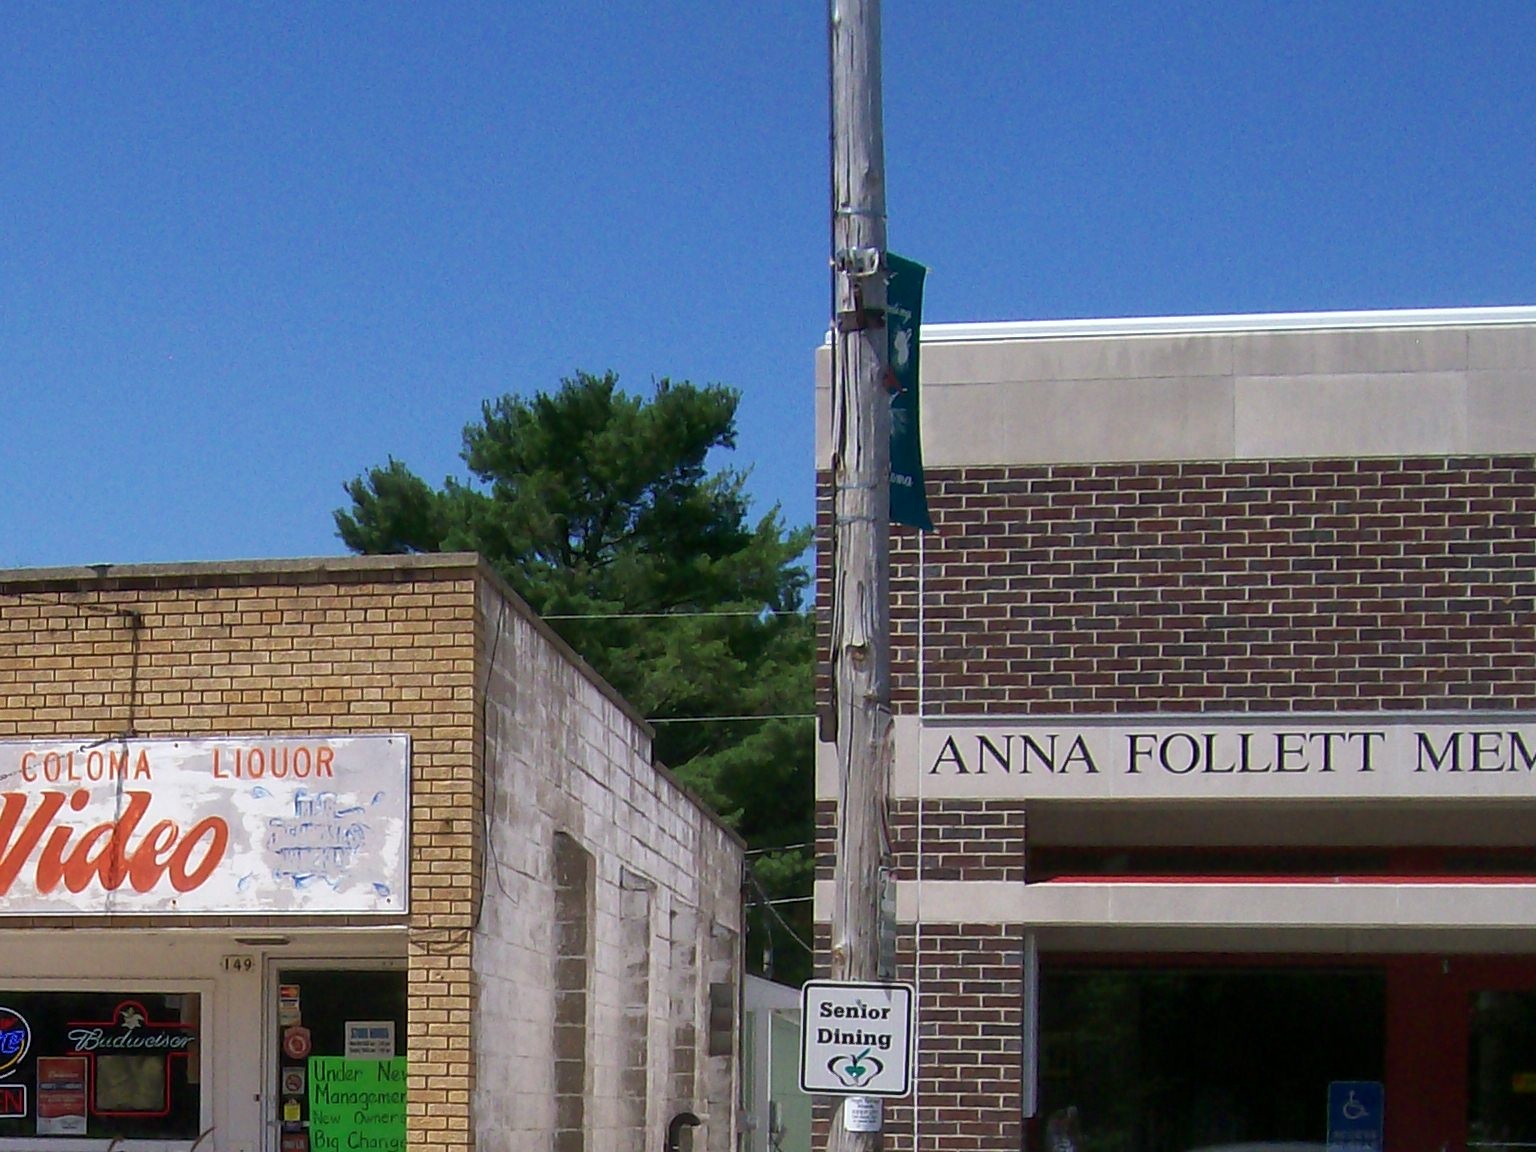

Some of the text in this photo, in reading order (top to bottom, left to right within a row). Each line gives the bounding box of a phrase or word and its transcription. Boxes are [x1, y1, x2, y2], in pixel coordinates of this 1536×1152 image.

[21, 747, 335, 782] COLOMA LIQUOR
[929, 734, 1099, 775] ANNA
[1124, 732, 1386, 774] FOLLETT
[225, 958, 252, 971] 149
[820, 1002, 891, 1019] Senior
[67, 1028, 195, 1051] Budweiser
[817, 1028, 892, 1050] Dining
[314, 1060, 363, 1082] Under
[313, 1110, 341, 1125] New
